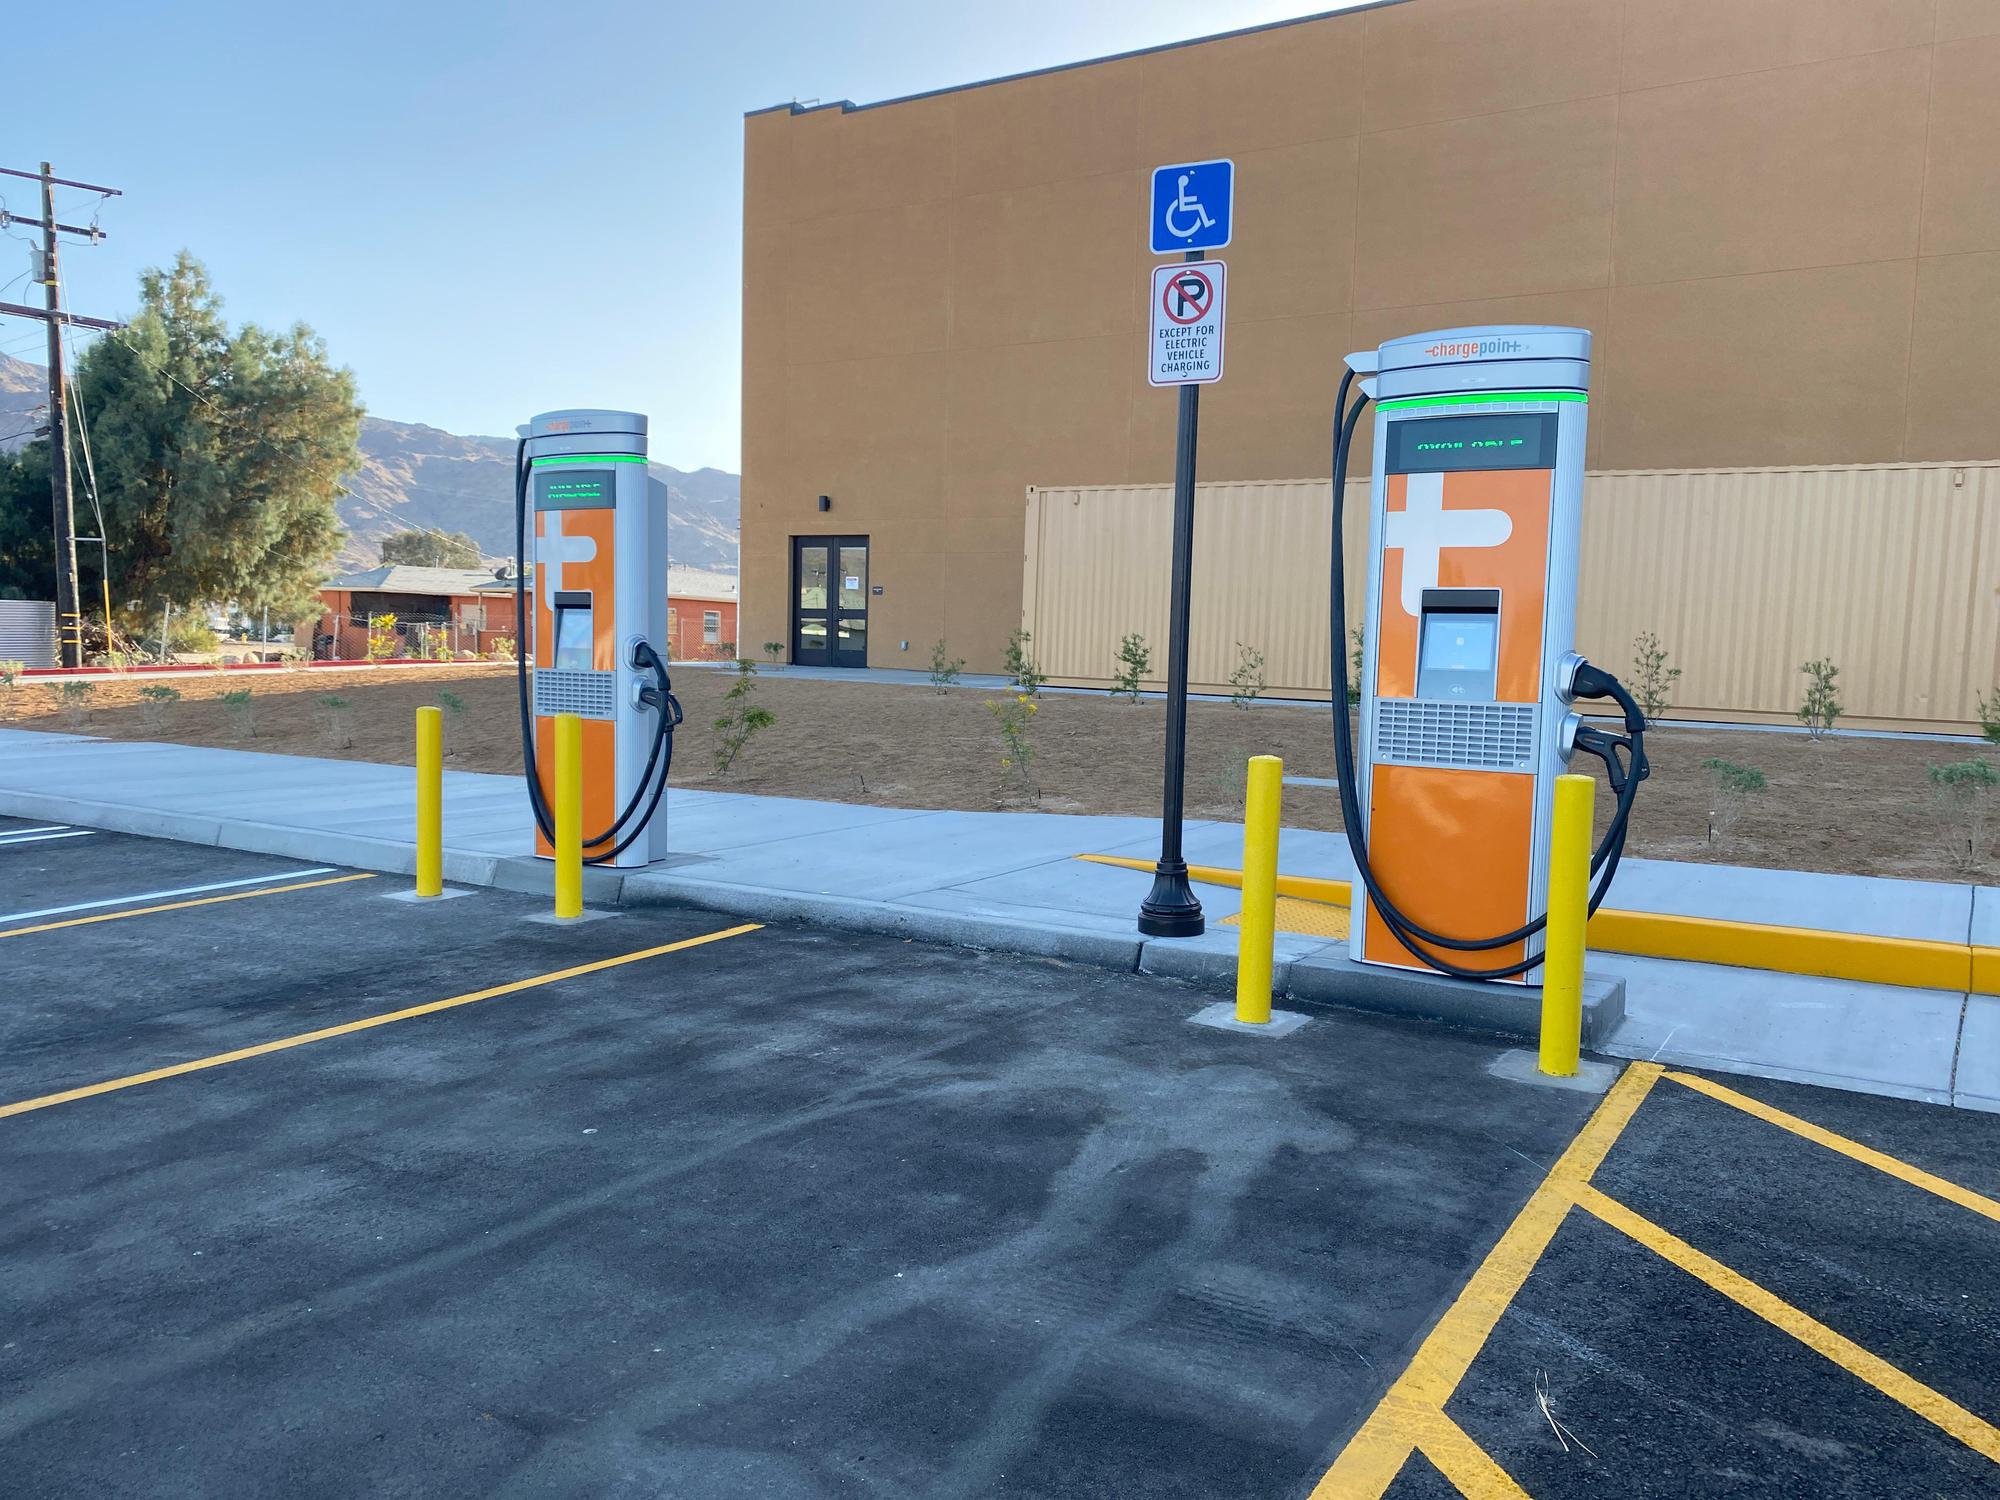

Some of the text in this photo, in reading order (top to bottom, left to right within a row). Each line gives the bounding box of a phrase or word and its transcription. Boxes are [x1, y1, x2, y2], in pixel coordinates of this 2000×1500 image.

[1159, 325, 1214, 339] EXCEPT FOR
[1165, 337, 1207, 350] ELECTRIC
[1167, 349, 1205, 361] VEHICLE
[1161, 360, 1210, 373] CHARGING
